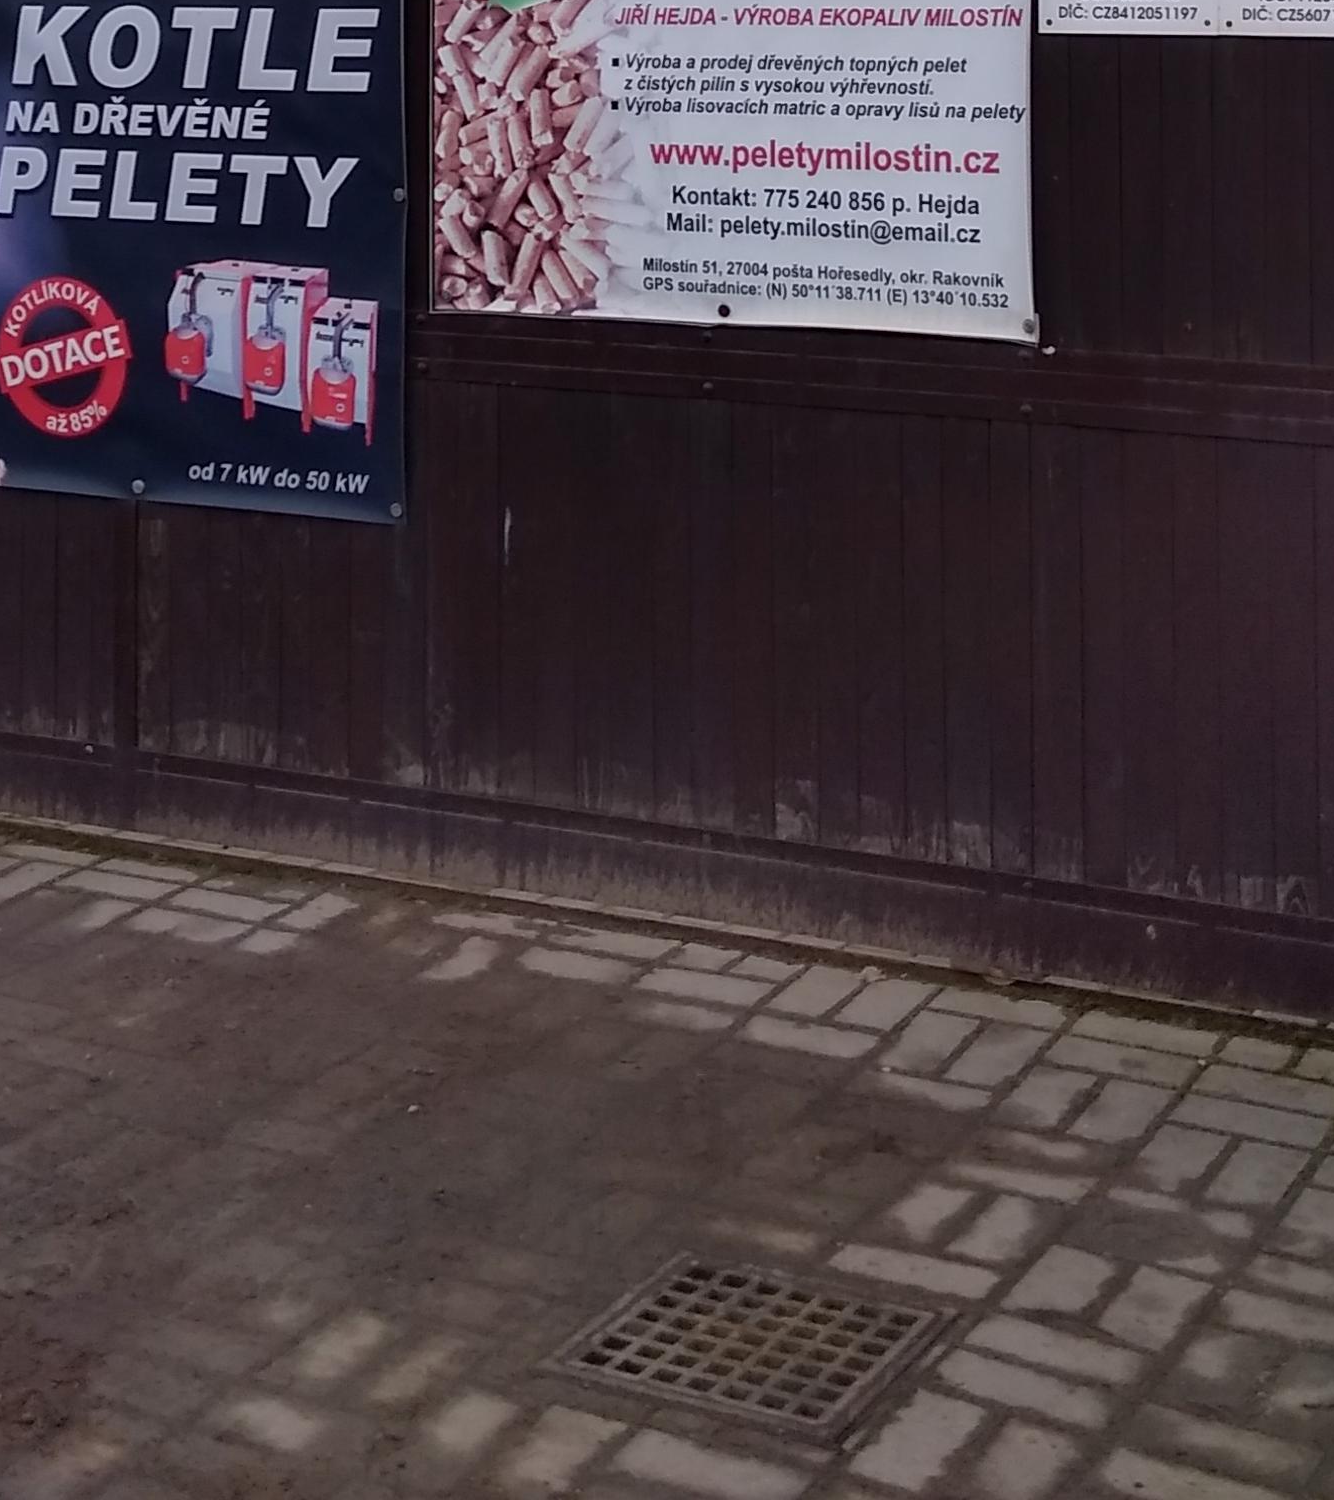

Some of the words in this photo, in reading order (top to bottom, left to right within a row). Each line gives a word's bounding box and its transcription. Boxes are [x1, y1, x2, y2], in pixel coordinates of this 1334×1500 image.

[615, 3, 652, 25] JIŘÍ
[653, 8, 716, 25] HEJDA
[734, 4, 814, 25] VÝROBA
[819, 8, 921, 27] EKOPALIV
[924, 4, 1023, 27] MILOSTÍN
[1092, 6, 1198, 20] CZ8412051197
[1242, 5, 1272, 21] DIČ:
[11, 5, 380, 94] KOTLE
[625, 53, 681, 72] Výroba
[686, 57, 695, 69] a
[699, 54, 753, 74] prodej
[757, 54, 844, 76] dřevěných
[849, 56, 918, 76] topných
[922, 57, 967, 76] pelet
[624, 78, 633, 90] z
[637, 75, 696, 95] čistých
[699, 76, 735, 95] pilin
[740, 80, 749, 92] s
[754, 78, 825, 96] vysokou
[830, 78, 934, 97] výhřevností.
[5, 101, 59, 135] NA
[73, 96, 270, 140] DŘEVĚNÉ
[624, 96, 682, 115] Výroba
[686, 97, 768, 114] lisovacích
[773, 97, 826, 116] matric
[831, 103, 840, 115] a
[845, 103, 904, 120] opravy
[909, 101, 940, 117] lisů
[945, 106, 966, 118] na
[970, 103, 1026, 123] pelety
[650, 140, 1000, 176] www.peletymilostin.cz
[672, 185, 757, 207] Kontakt:
[764, 188, 800, 208] 775
[806, 190, 842, 209] 240
[848, 192, 885, 211] 856
[892, 196, 911, 216] p.
[918, 194, 980, 218] Hejda
[666, 213, 714, 232] Mail:
[720, 216, 981, 245] pelety.milostin@email.cz
[643, 258, 698, 273] Milostín
[702, 261, 723, 276] 51,
[727, 262, 768, 276] 27004
[772, 264, 813, 280] pošta
[817, 265, 895, 285] Hořesedly,
[900, 269, 928, 284] okr.
[932, 271, 1004, 288] Rakovník
[643, 277, 674, 291] GPS
[678, 279, 762, 295] souřadnice:
[766, 283, 787, 300] (N)
[887, 289, 908, 305] (E)
[4, 280, 101, 337] KOTLÍKOVÁ
[0, 325, 125, 387] DOTACE
[46, 414, 68, 432] až
[71, 400, 107, 431] 85%
[188, 462, 215, 481] od
[219, 464, 232, 482] 7
[236, 465, 270, 485] kW
[274, 469, 300, 488] do
[305, 471, 330, 491] 50
[335, 473, 369, 494] kW
